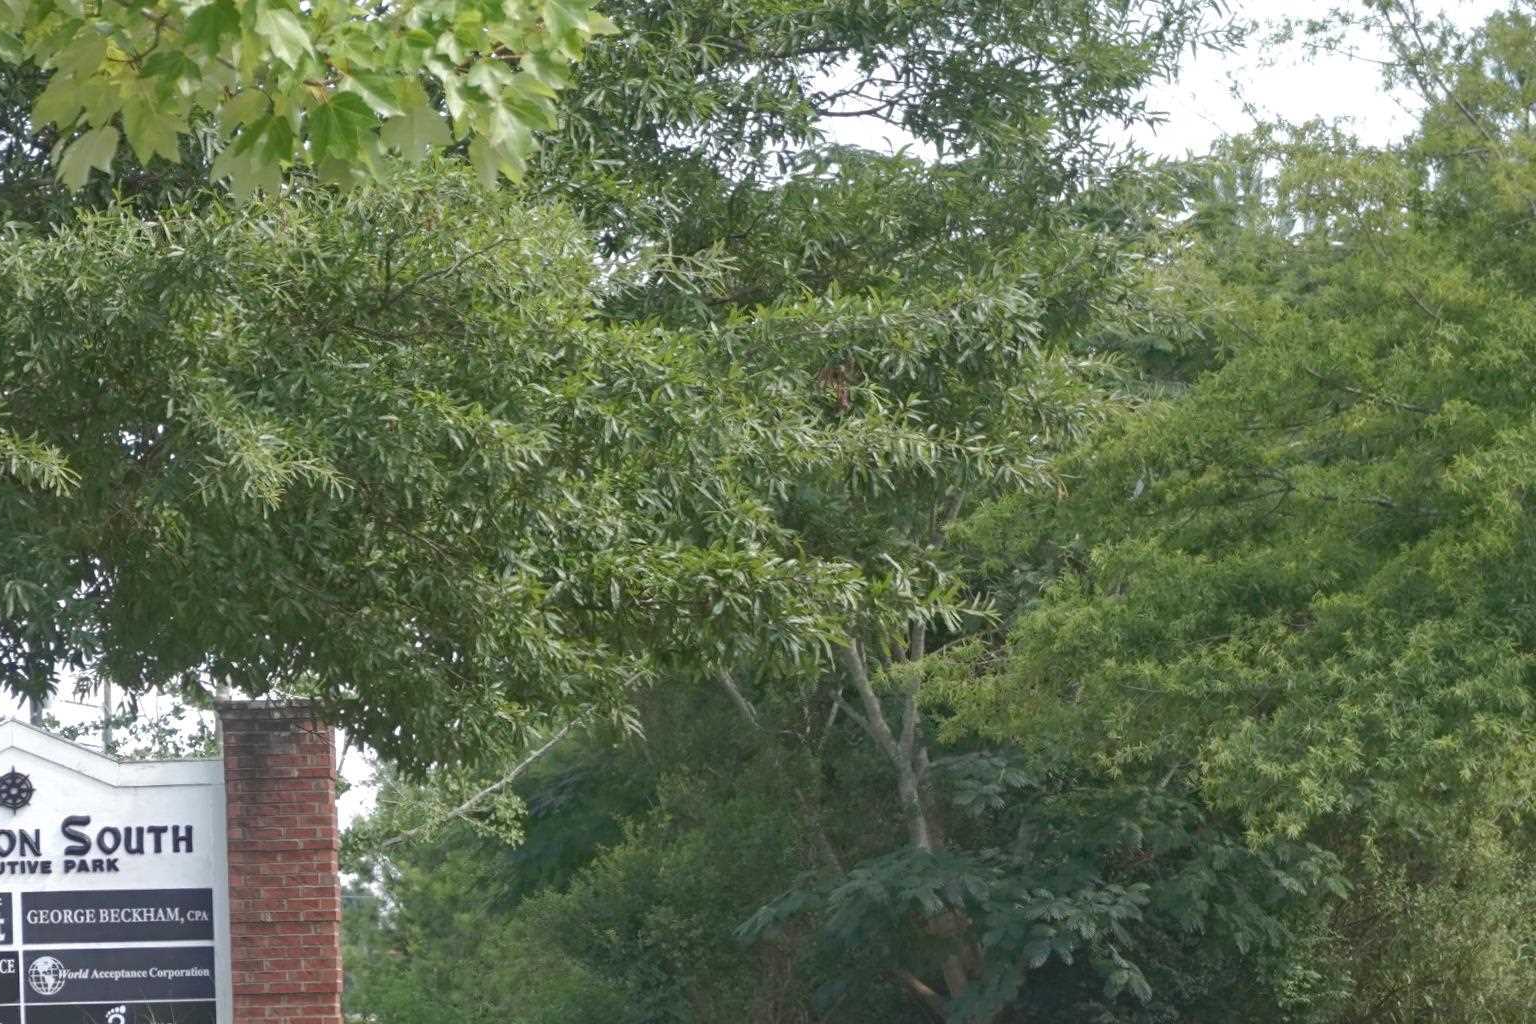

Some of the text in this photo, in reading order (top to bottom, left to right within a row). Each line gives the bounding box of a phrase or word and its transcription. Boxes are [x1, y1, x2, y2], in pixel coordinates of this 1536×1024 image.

[61, 815, 194, 857] SOUTH
[63, 857, 120, 874] PARK
[27, 907, 209, 924] GEORGE BECKHAM, CPA
[58, 966, 210, 980] World Acceptance Corporation
